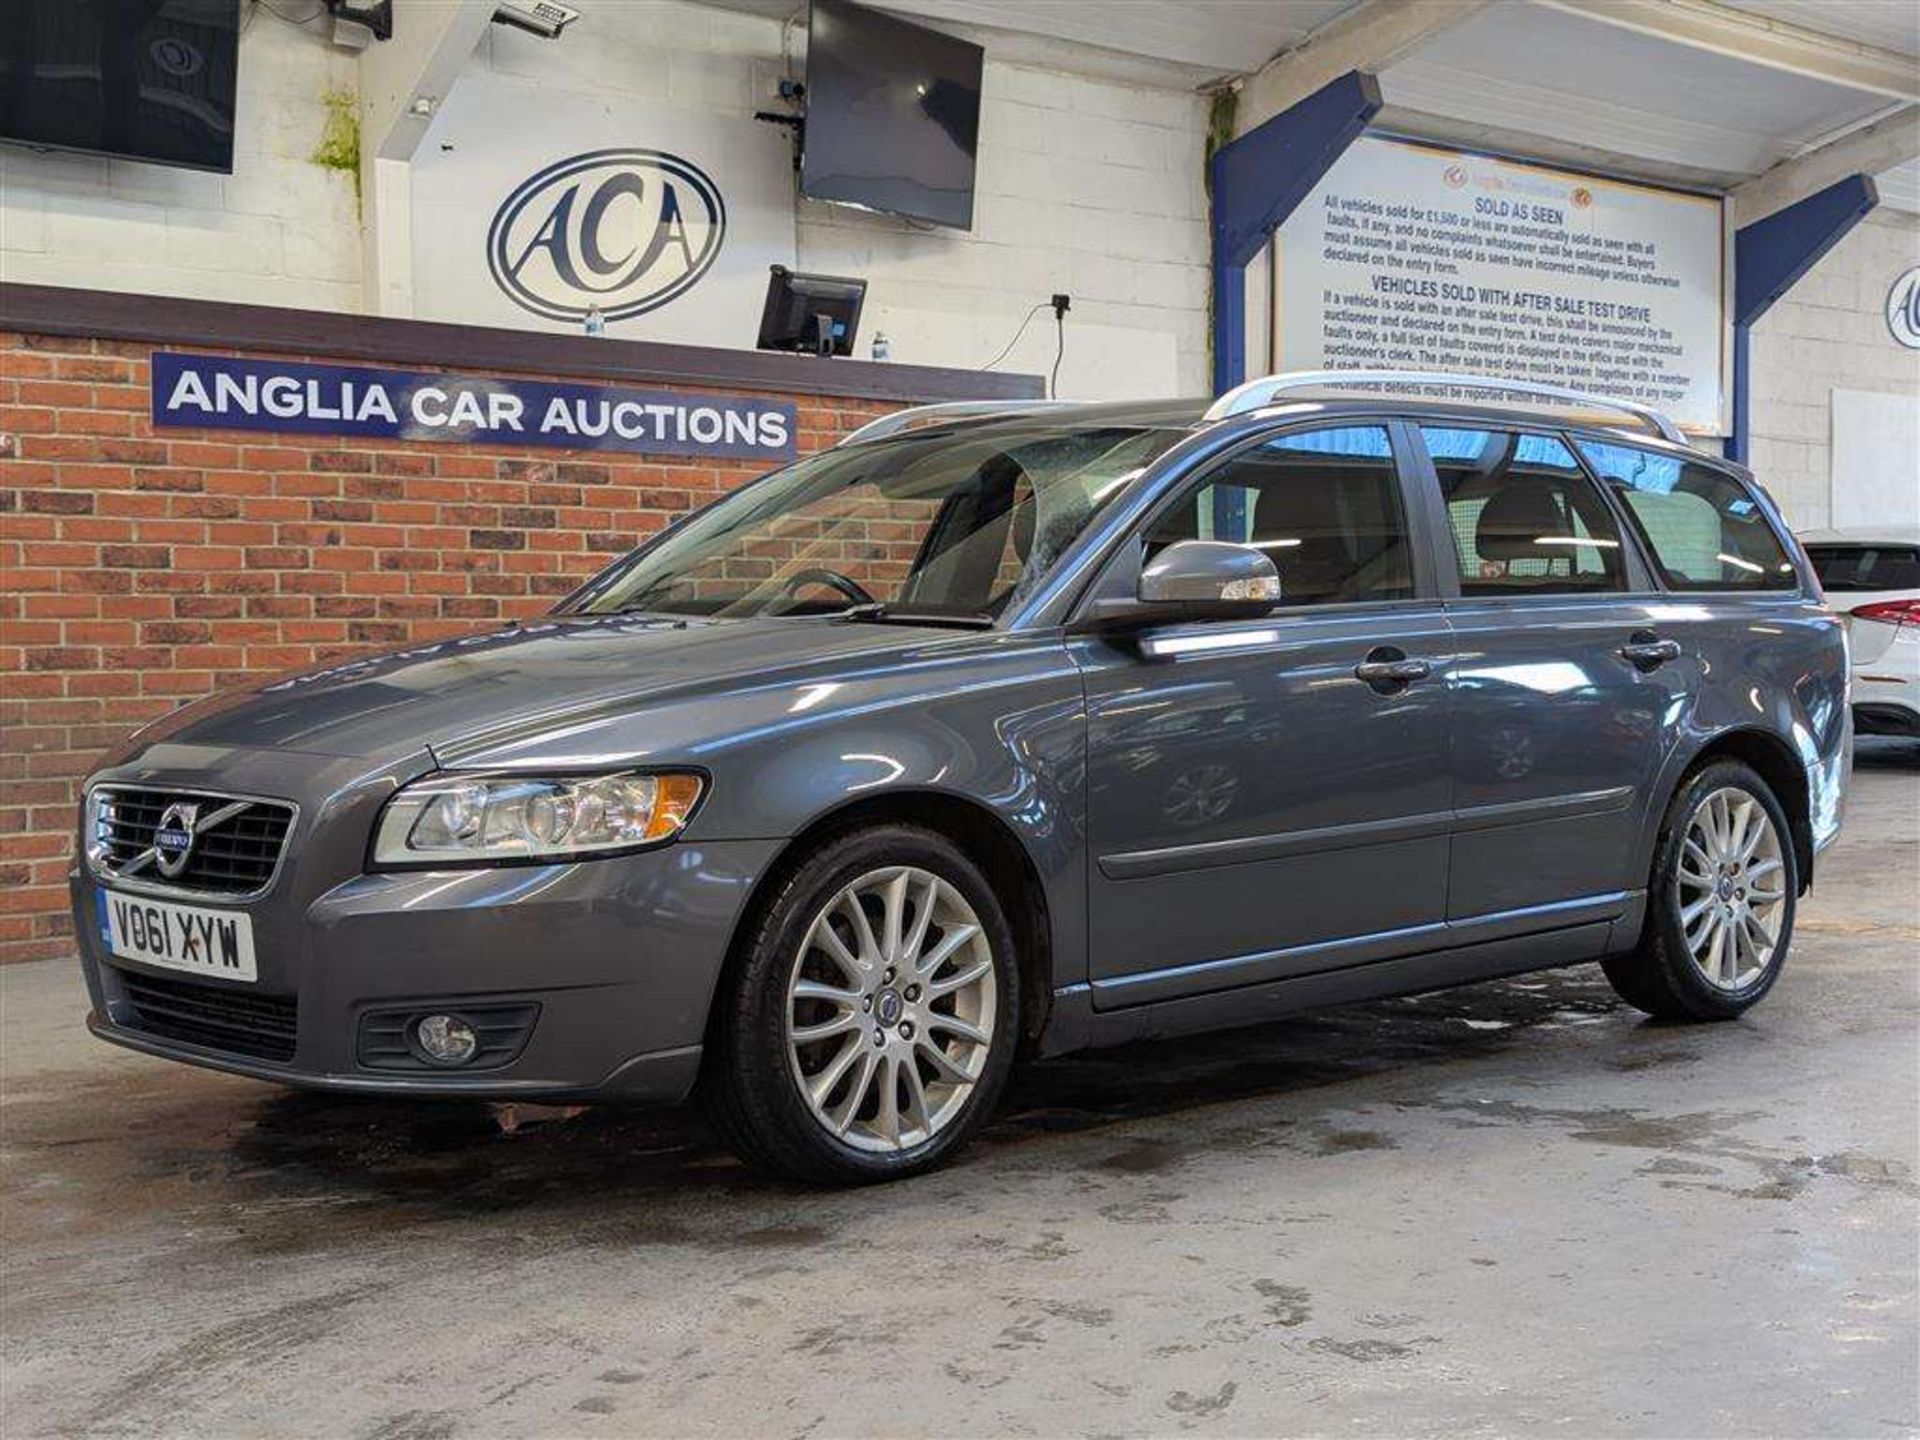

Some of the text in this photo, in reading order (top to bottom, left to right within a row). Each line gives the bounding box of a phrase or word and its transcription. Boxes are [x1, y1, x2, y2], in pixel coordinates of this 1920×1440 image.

[510, 172, 697, 293] ACA
[1324, 195, 1339, 208] All
[1341, 200, 1383, 214] vehicles
[1386, 205, 1408, 218] sold
[1410, 207, 1424, 220] for
[1460, 217, 1470, 226] or
[1473, 217, 1492, 230] less
[1494, 223, 1508, 233] are
[1511, 223, 1569, 244] automatically
[1572, 233, 1590, 245] sold
[1592, 237, 1602, 247] as
[1605, 239, 1624, 250] seen
[1626, 241, 1643, 253] with
[1475, 197, 1564, 225] SOLD AS SEEN
[1323, 231, 1680, 288] must assume all vehicles sold as seen have incorrect mileage unless otherwise
[1323, 247, 1369, 263] declared
[1371, 255, 1384, 265] on
[1387, 253, 1402, 267] the
[1406, 258, 1431, 274] entry
[1362, 217, 1369, 229] if
[1395, 223, 1414, 236] and
[1416, 229, 1429, 239] no
[1432, 227, 1483, 246] complaints
[1486, 236, 1537, 252] whatsoever
[1539, 243, 1559, 255] shall
[1562, 246, 1572, 258] be
[1627, 255, 1655, 271] Buyers
[1334, 294, 1340, 304] a
[1343, 292, 1379, 308] vehicle
[1381, 297, 1391, 309] is
[1394, 299, 1415, 312] sold
[1418, 302, 1439, 315] with
[1441, 306, 1453, 316] an
[1455, 305, 1476, 318] after
[1479, 308, 1497, 321] sale
[1500, 311, 1517, 323] test
[1547, 315, 1564, 328] this
[1566, 318, 1586, 331] shall
[1589, 320, 1599, 332] be
[1601, 322, 1646, 337] announced
[1648, 327, 1657, 341] by
[1660, 328, 1672, 340] the
[1372, 275, 1650, 323] VEHICLES SOLD WITH AFTER SALE TEST DRIVE
[1323, 309, 1378, 325] auctioneer
[1381, 314, 1399, 327] and
[1402, 316, 1444, 331] declared
[1447, 322, 1459, 332] on
[1462, 322, 1476, 334] the
[1479, 325, 1501, 339] entry
[1529, 330, 1537, 341] A
[1539, 331, 1555, 342] test
[1558, 332, 1580, 346] drive
[1582, 336, 1610, 348] covers
[1613, 339, 1638, 353] major
[1638, 341, 1683, 356] mechanical
[1323, 325, 1352, 339] faults
[1382, 333, 1388, 343] a
[1391, 331, 1406, 344] full
[1409, 332, 1424, 345] list
[1427, 334, 1437, 347] of
[1440, 336, 1466, 350] faults
[1468, 340, 1505, 354] covered
[1507, 343, 1515, 355] is
[1517, 344, 1560, 361] displayed
[1573, 349, 1587, 361] the
[1589, 350, 1612, 363] office
[1614, 352, 1630, 365] and
[1632, 354, 1649, 367] with
[1651, 356, 1664, 368] the
[1323, 343, 1386, 359] auctioneer's
[1419, 350, 1437, 363] The
[1440, 351, 1462, 365] after
[1464, 354, 1482, 367] sale
[1485, 356, 1502, 369] test
[1505, 358, 1527, 371] drive
[1529, 361, 1551, 374] must
[1554, 363, 1564, 375] be
[1595, 365, 1630, 381] together
[1633, 369, 1649, 382] with
[1658, 372, 1690, 386] member
[1569, 379, 1585, 392] Any
[1588, 382, 1633, 396] complaints
[1635, 384, 1643, 396] of
[166, 370, 788, 448] ANGLIA CAR AUCTIONS
[176, 912, 240, 969] XYW
